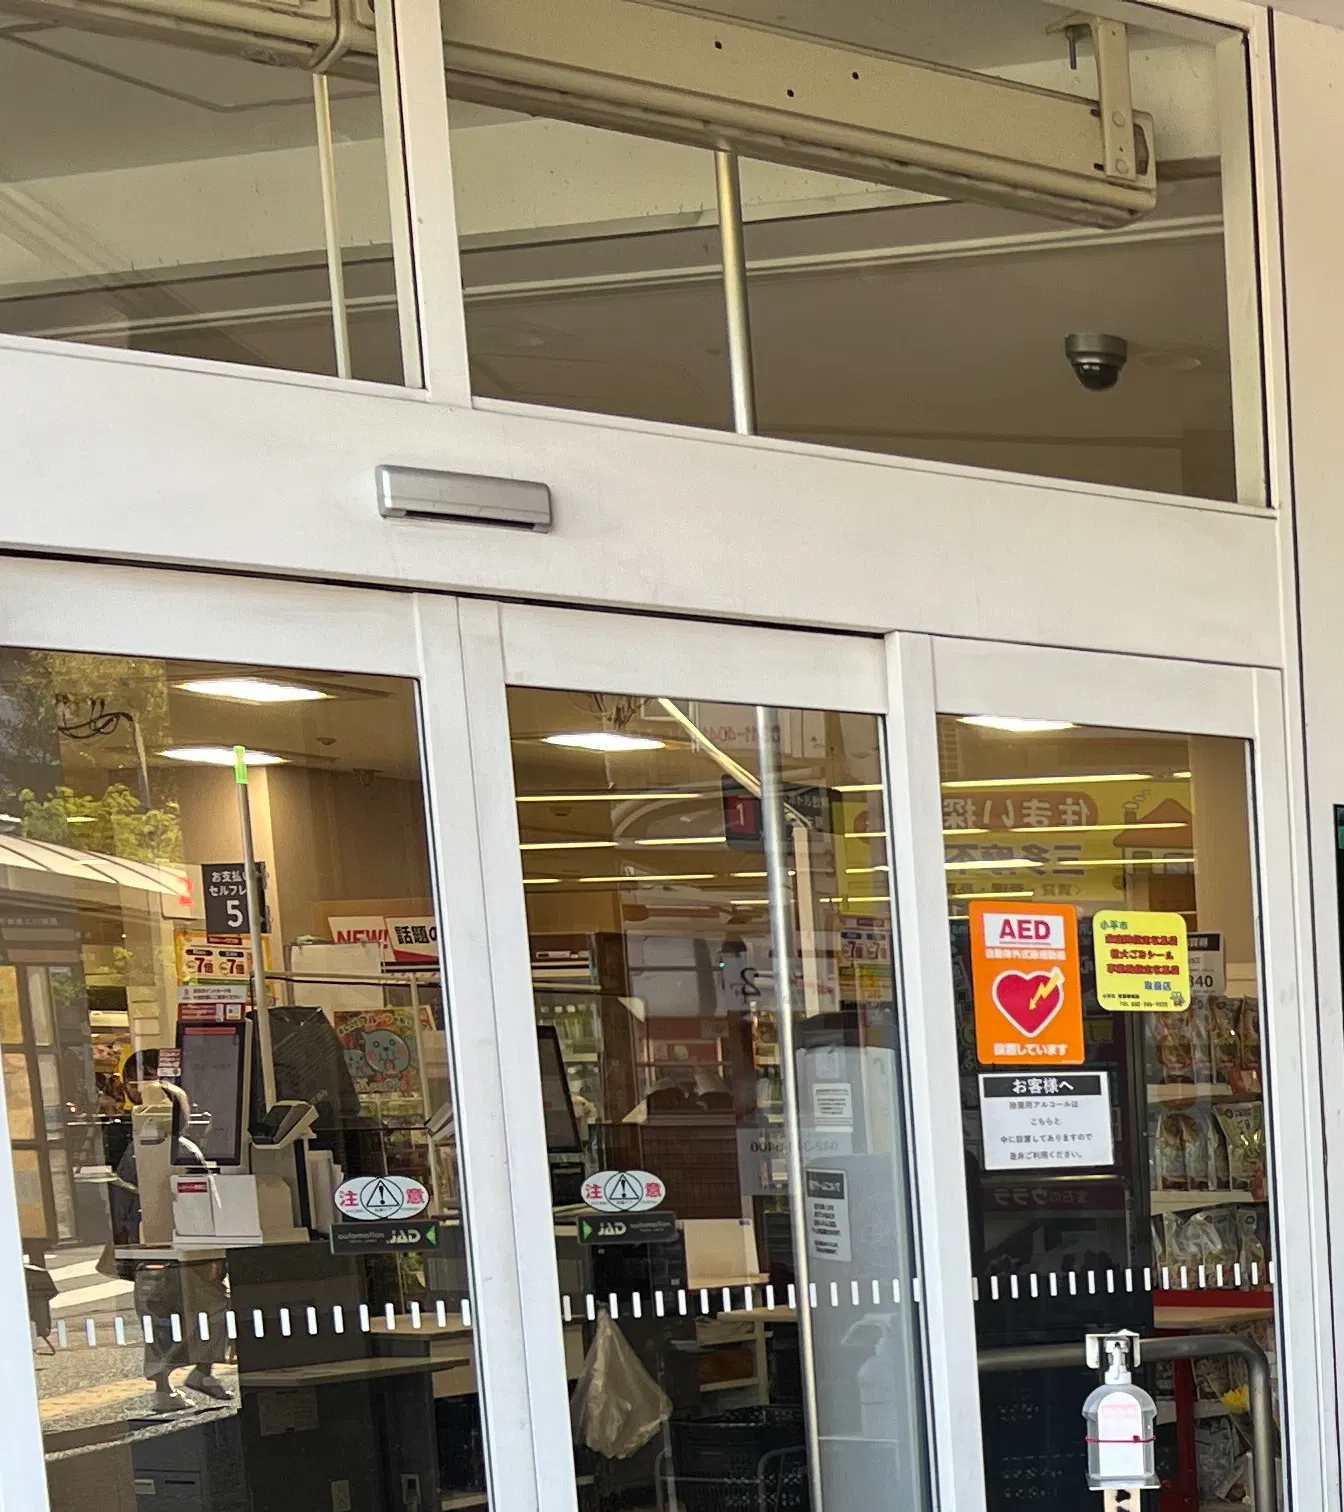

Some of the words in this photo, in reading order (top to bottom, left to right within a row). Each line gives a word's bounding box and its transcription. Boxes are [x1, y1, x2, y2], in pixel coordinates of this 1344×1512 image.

[211, 870, 247, 883] お支払
[209, 885, 247, 897] セルフレ
[227, 900, 243, 927] 5
[999, 918, 1051, 940] AED
[993, 1042, 1068, 1056] 設置しています
[1012, 1077, 1074, 1094] お客様へ
[339, 1190, 359, 1207] 注
[585, 1183, 603, 1199] 注
